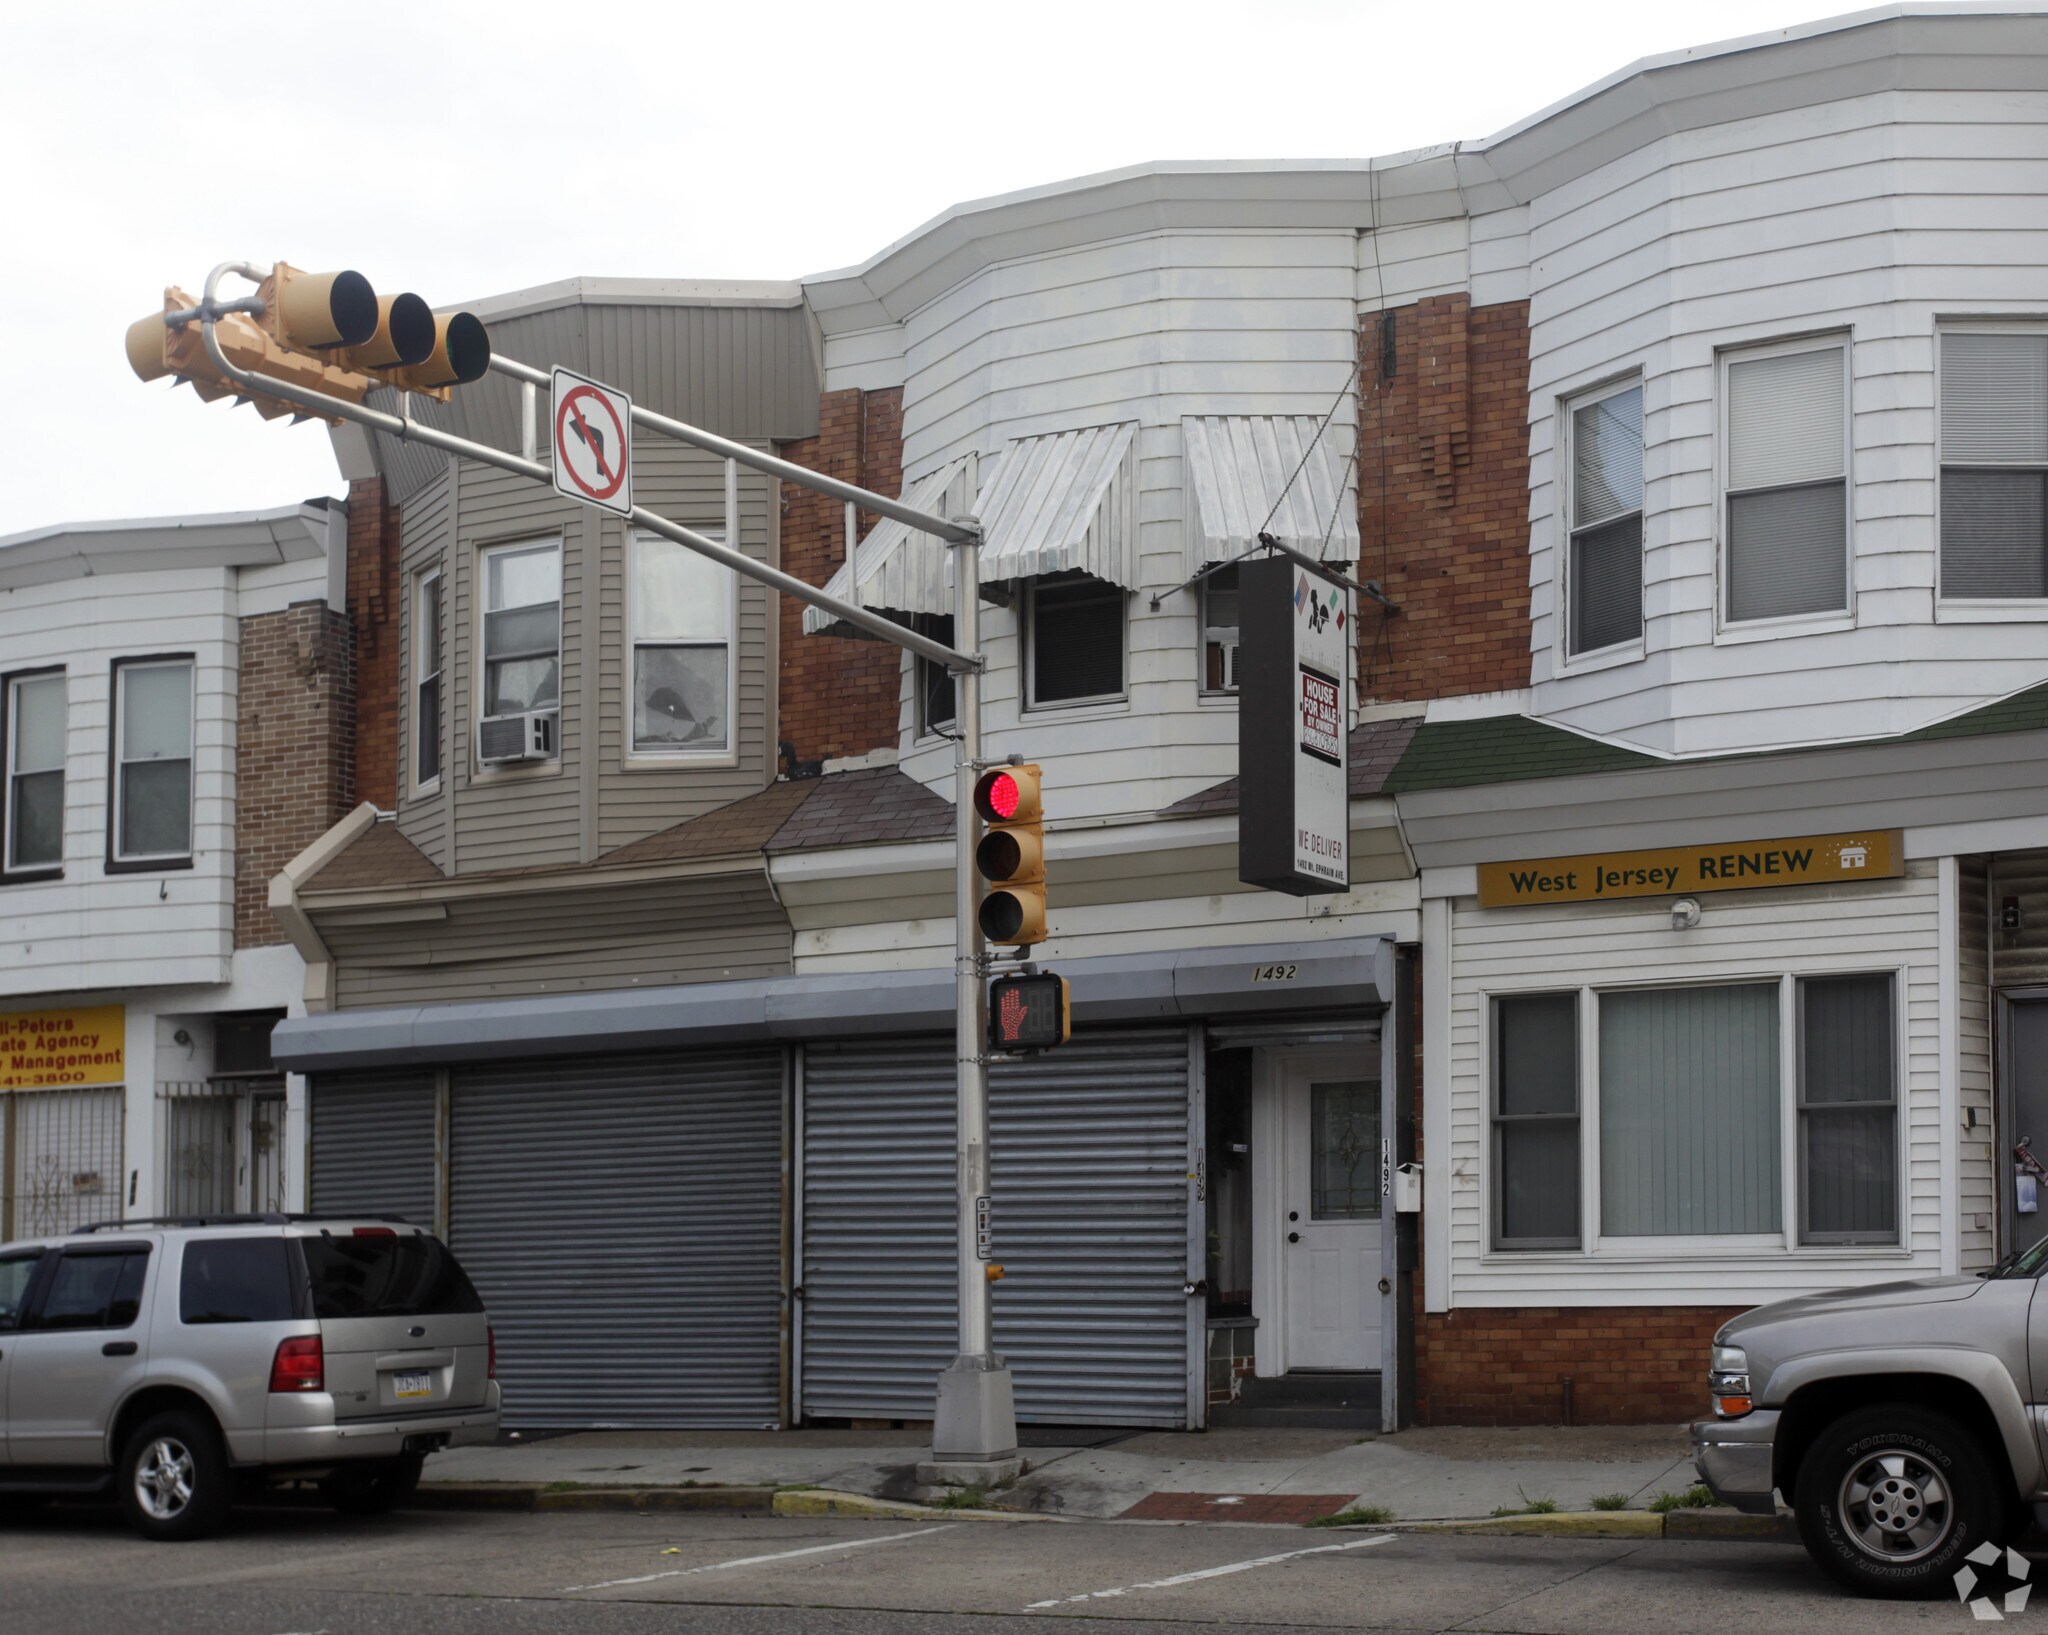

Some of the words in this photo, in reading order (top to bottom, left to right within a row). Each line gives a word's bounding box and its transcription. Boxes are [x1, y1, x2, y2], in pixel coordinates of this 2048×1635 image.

[1306, 678, 1334, 706] HOUSE
[1304, 697, 1318, 716] FOR
[1319, 705, 1336, 724] SALE
[1307, 715, 1315, 728] BY
[1315, 720, 1334, 735] OWNER
[1298, 829, 1308, 850] WE
[1311, 833, 1342, 860] DELIVER
[1315, 864, 1334, 877] EPHRAIM
[1509, 870, 1577, 893] West
[1595, 865, 1680, 894] Jersey
[1699, 848, 1814, 879] RENEW
[1254, 965, 1297, 981] 1492
[35, 1033, 100, 1052] Agency
[11, 1048, 121, 1070] Management
[0, 1071, 85, 1086] 41-3800
[1846, 1433, 1952, 1467] YOKOHAMA
